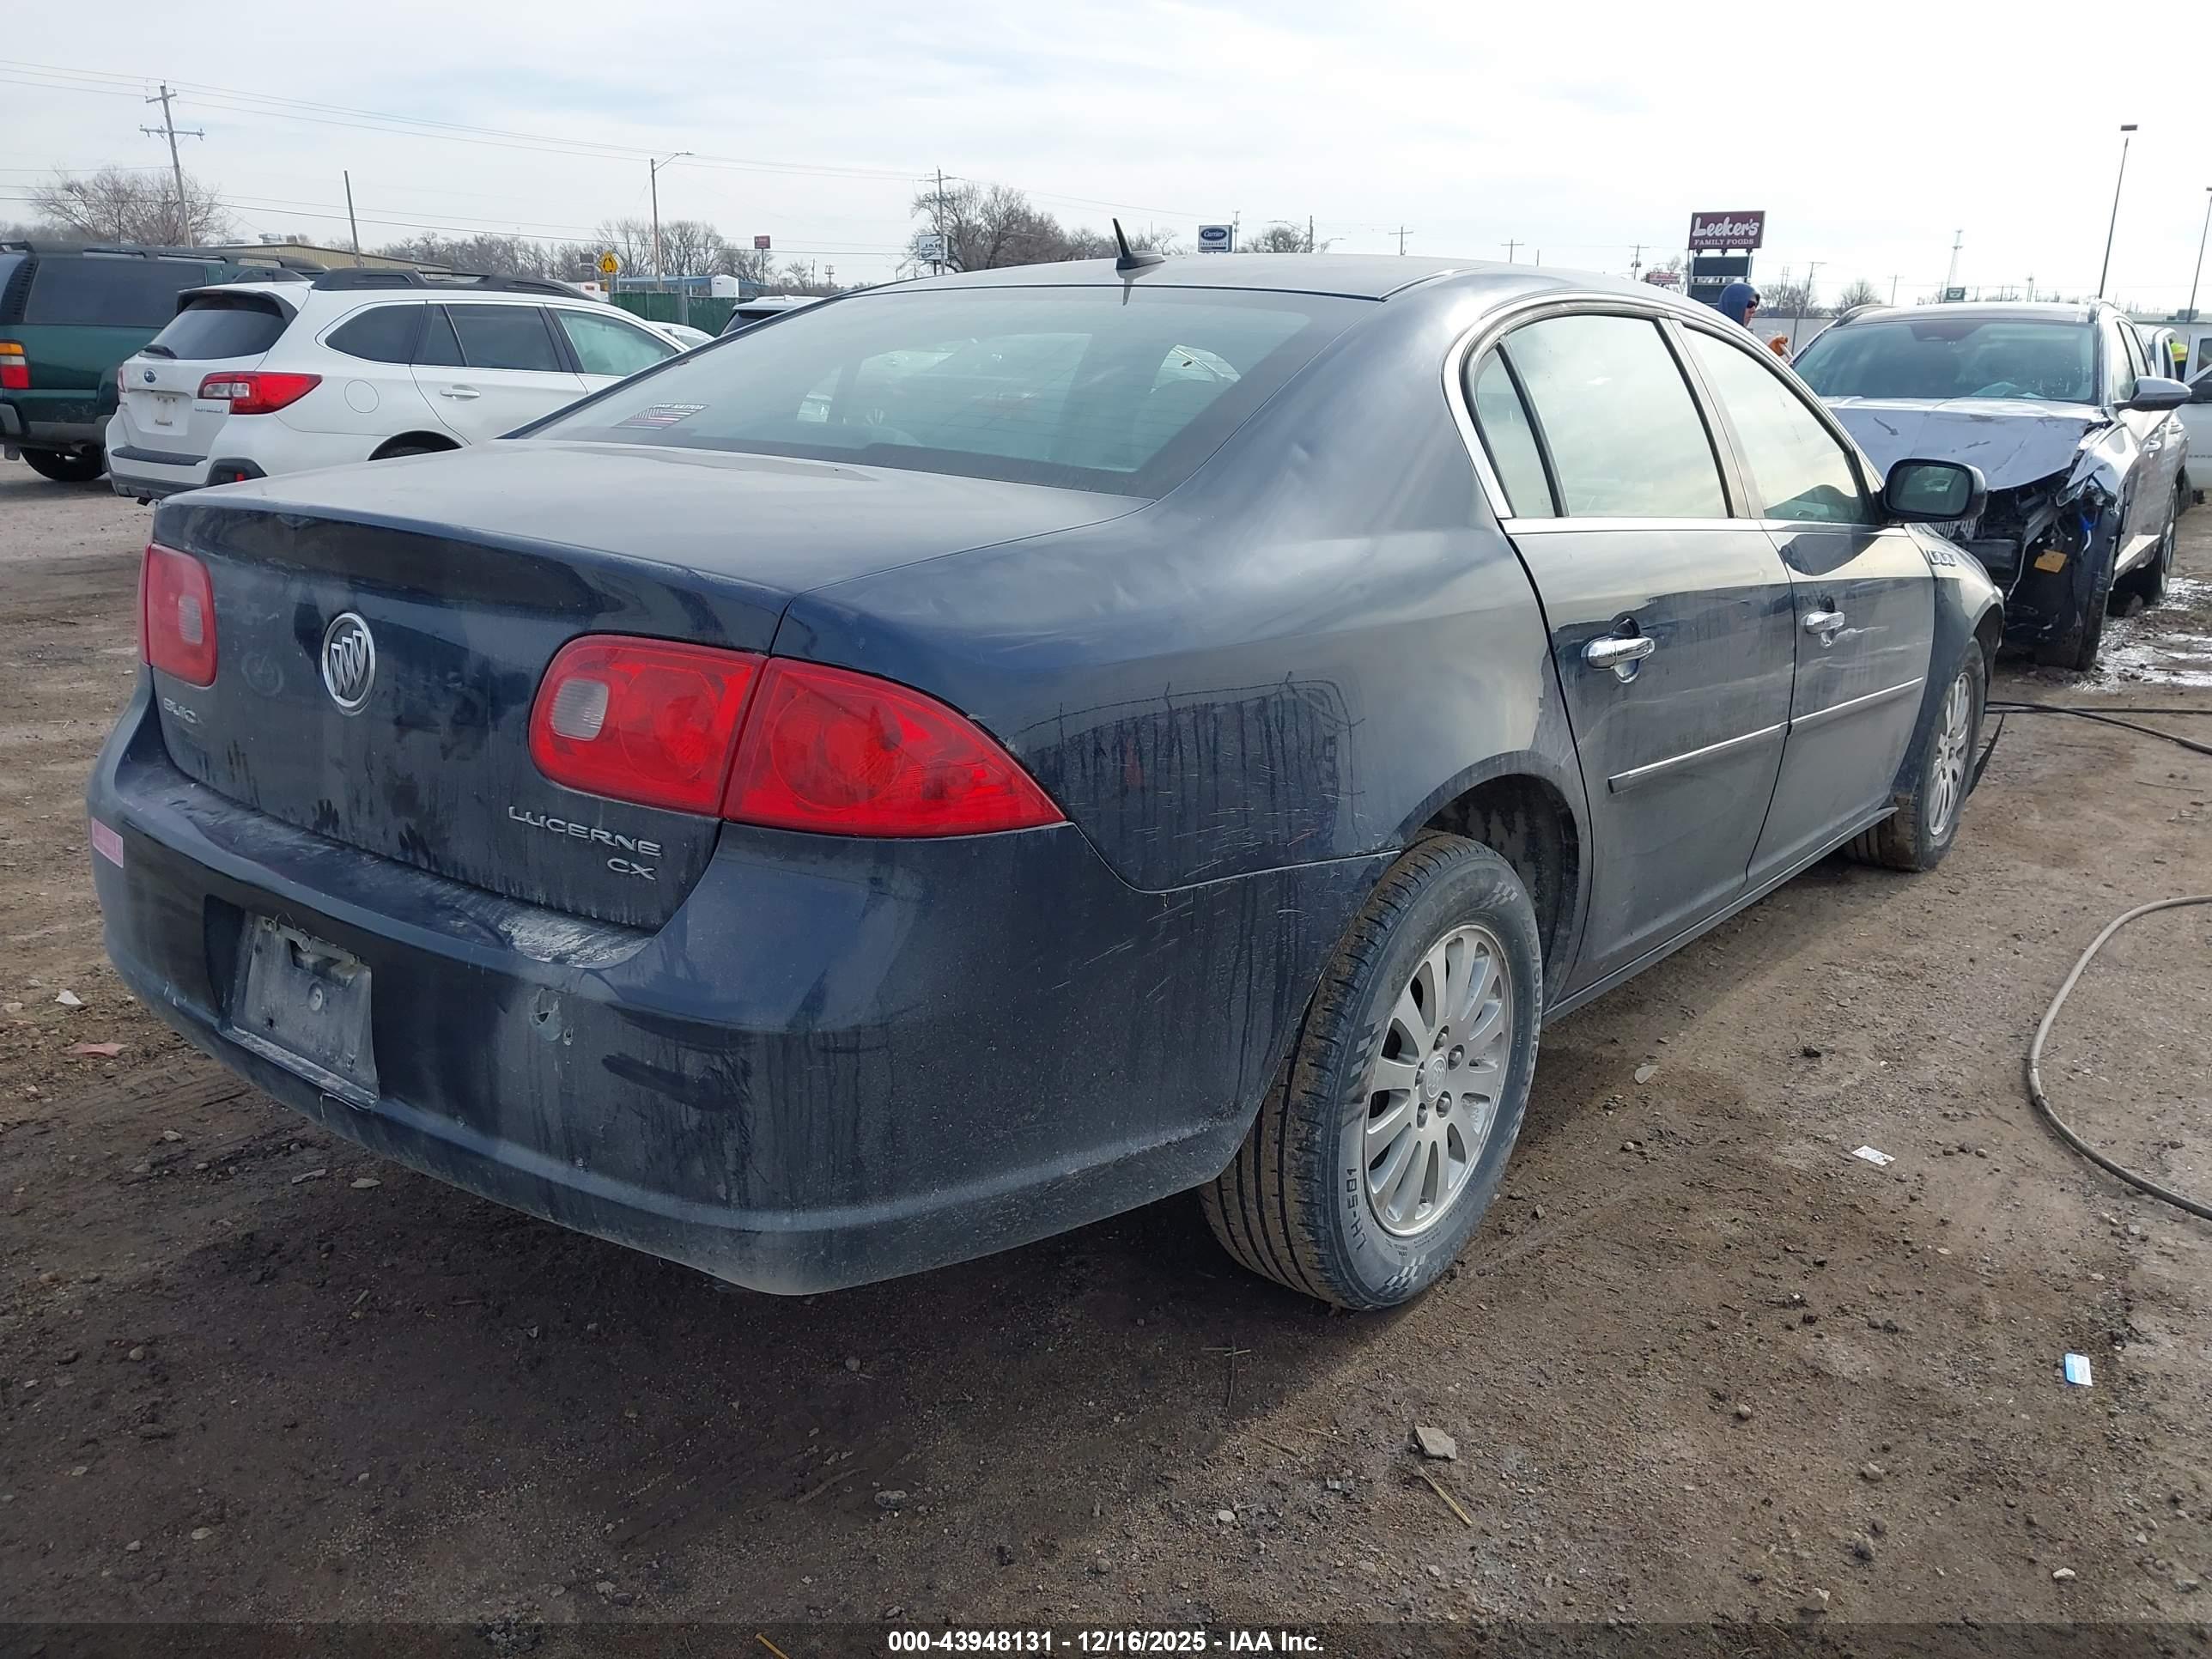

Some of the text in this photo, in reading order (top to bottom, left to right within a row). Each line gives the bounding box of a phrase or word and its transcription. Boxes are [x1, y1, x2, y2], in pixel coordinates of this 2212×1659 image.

[1692, 216, 1759, 236] Leeker's
[508, 805, 662, 857] LUCERNE
[606, 858, 656, 880] CX
